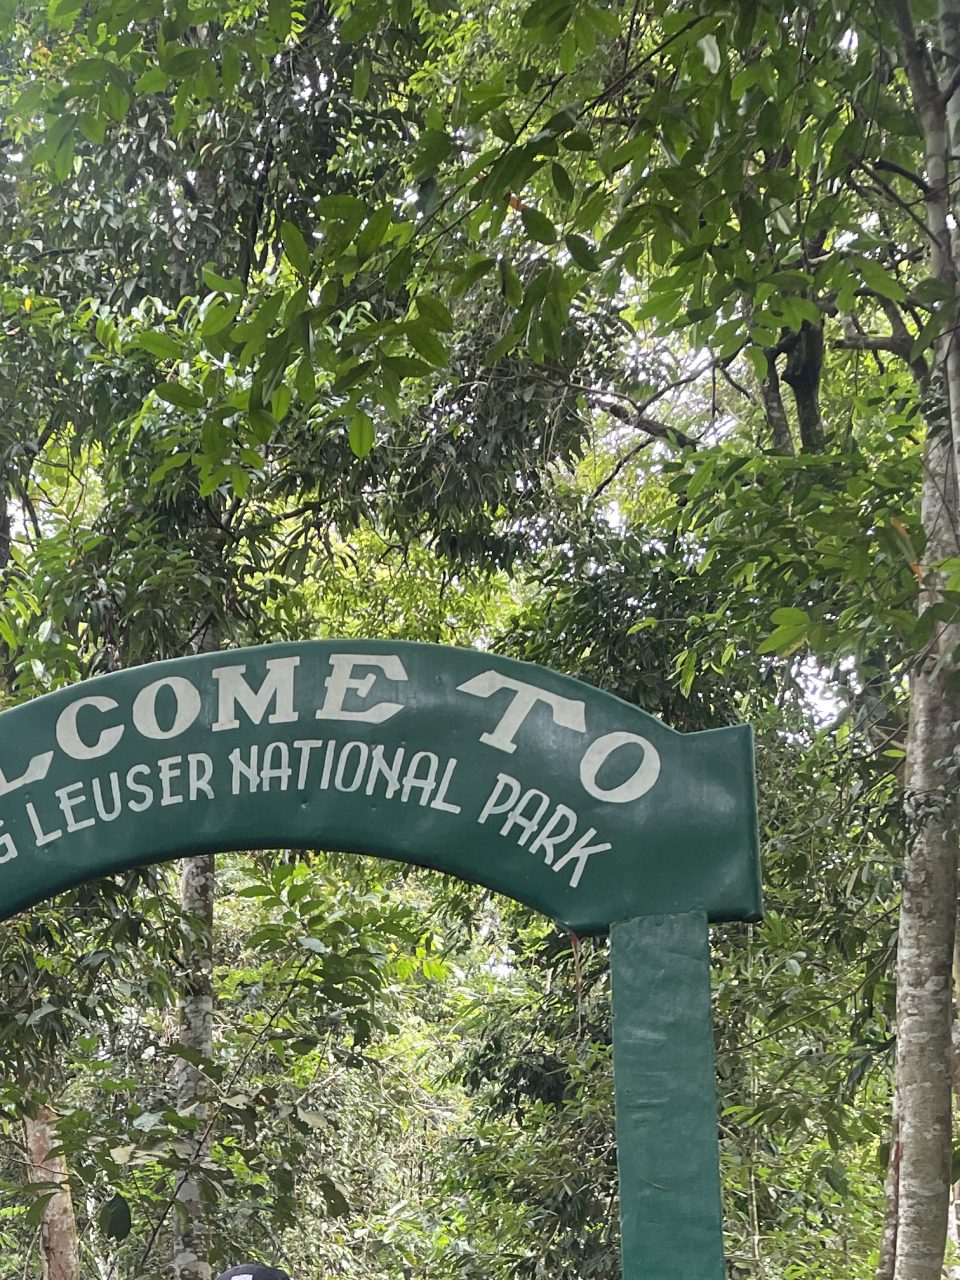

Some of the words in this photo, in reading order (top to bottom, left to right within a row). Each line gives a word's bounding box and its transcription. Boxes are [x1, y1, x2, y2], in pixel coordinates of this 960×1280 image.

[456, 669, 661, 803] TO
[26, 752, 215, 847] LEUSER
[228, 739, 461, 815] NATIONAL
[477, 772, 612, 889] PARK
